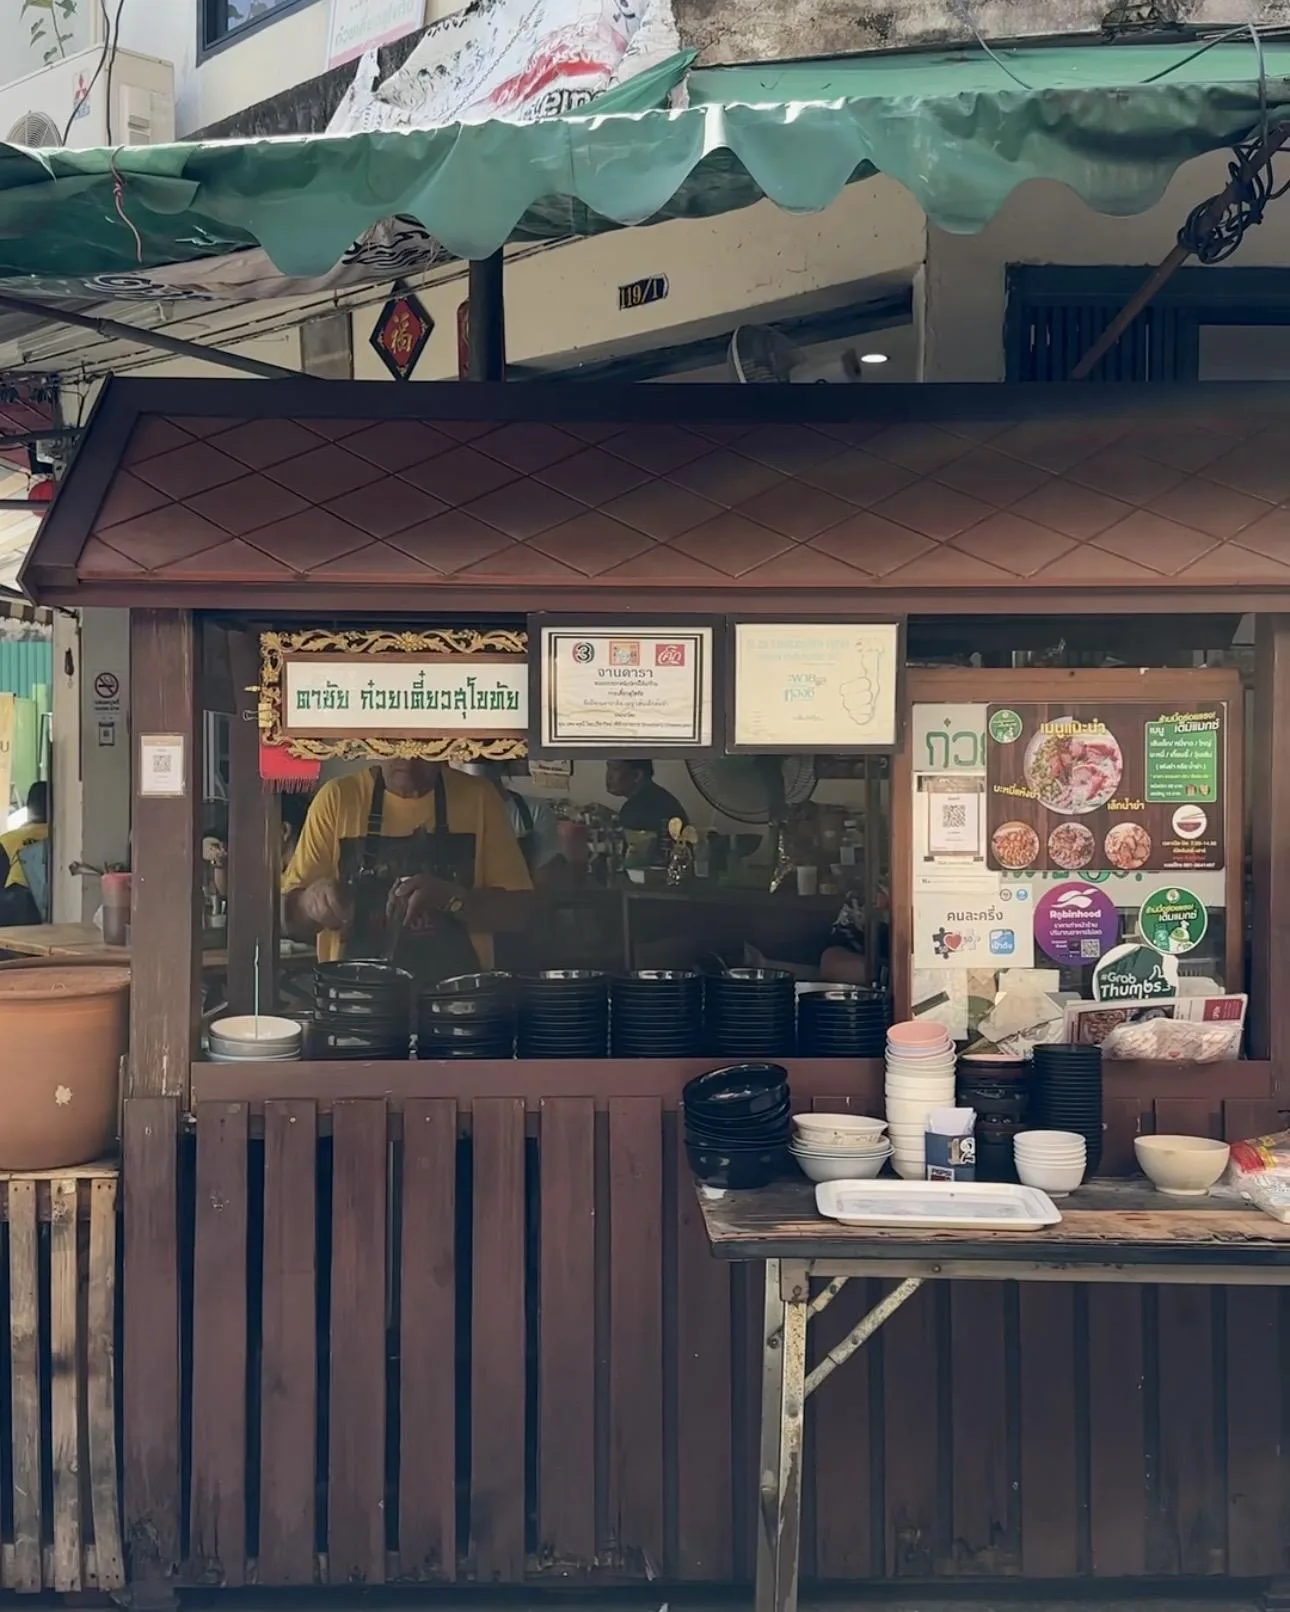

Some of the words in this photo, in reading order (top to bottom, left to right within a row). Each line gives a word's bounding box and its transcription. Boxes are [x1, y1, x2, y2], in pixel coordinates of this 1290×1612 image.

[621, 277, 659, 307] 119/1
[296, 681, 350, 710] ตาชัย
[360, 670, 520, 719] ก๋วยเตี๋ยวสุโขทัย
[926, 718, 985, 768] ก๋ว
[947, 905, 1004, 921] คนละครึ่ง
[1049, 909, 1102, 919] Robinhood
[1101, 979, 1162, 1000] Thumbs
